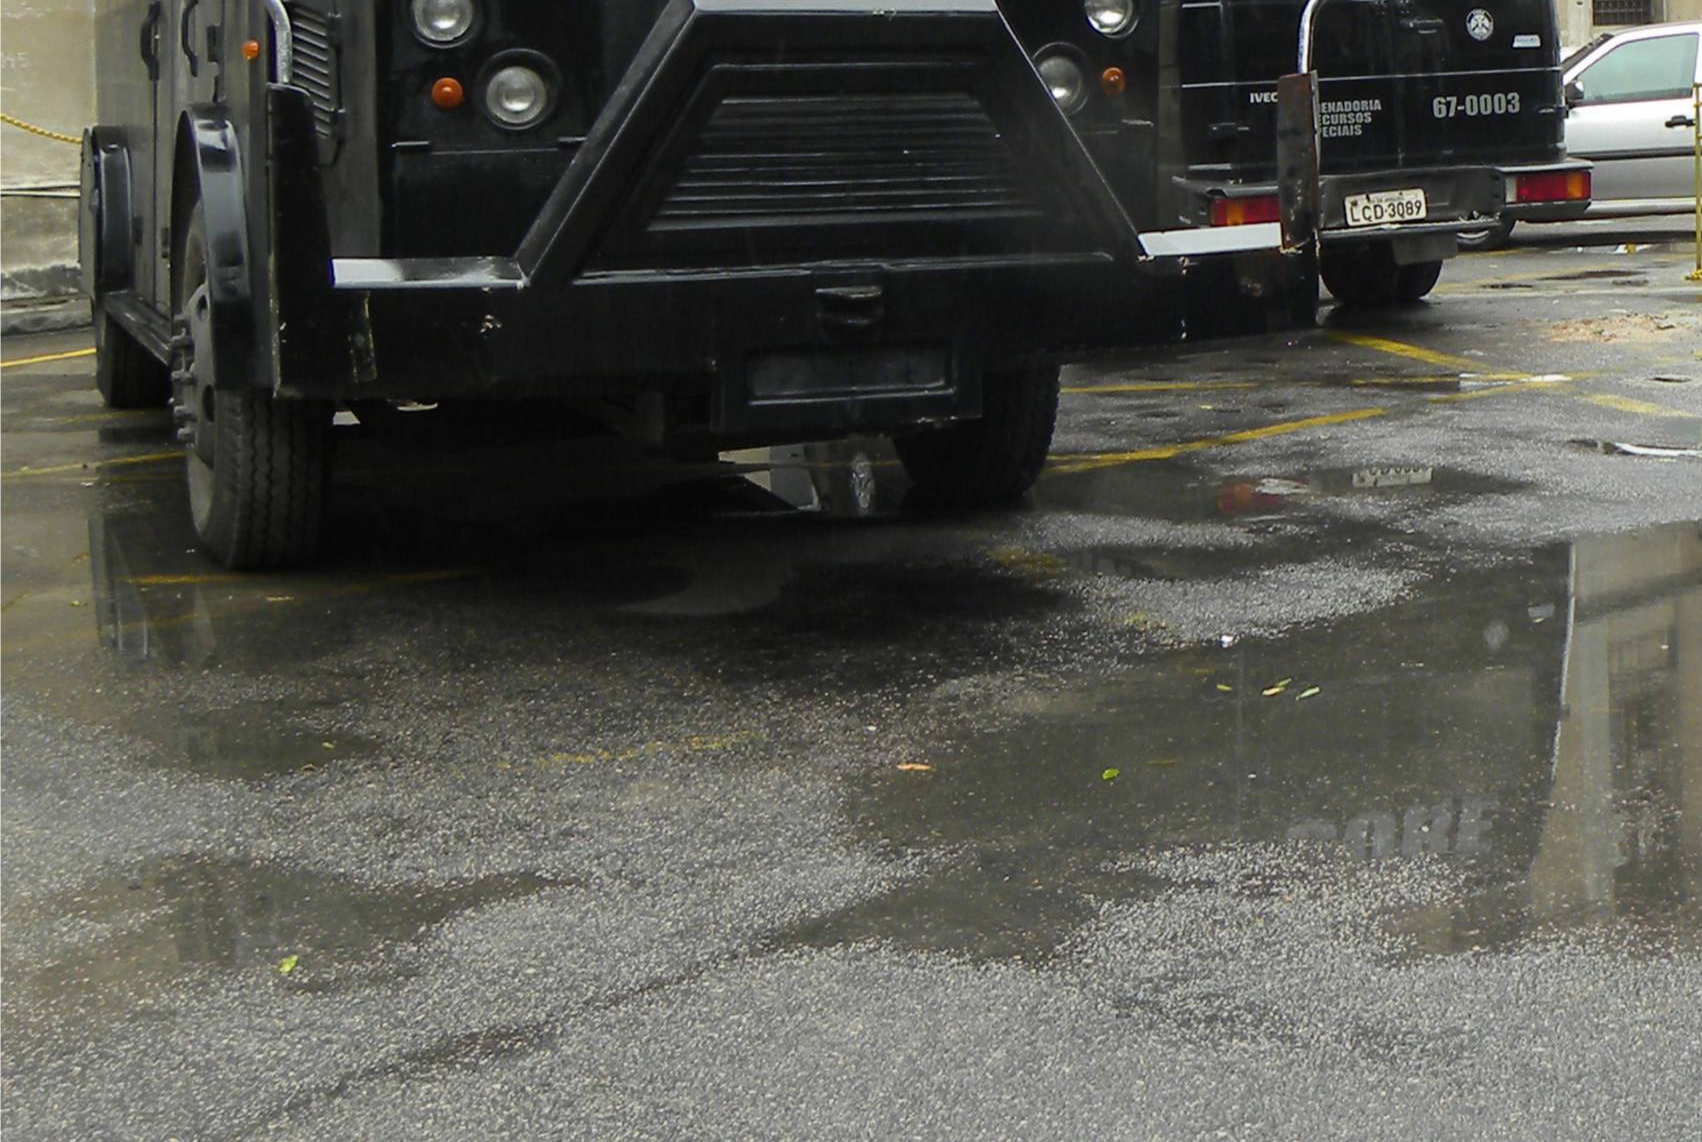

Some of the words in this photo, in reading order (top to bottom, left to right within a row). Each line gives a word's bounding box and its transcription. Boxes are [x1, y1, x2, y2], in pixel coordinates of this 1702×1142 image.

[1249, 92, 1278, 104] IVEC
[1432, 91, 1521, 119] 67-0003
[1320, 99, 1382, 114] ENADORIA
[1321, 124, 1363, 138] ECIAIS
